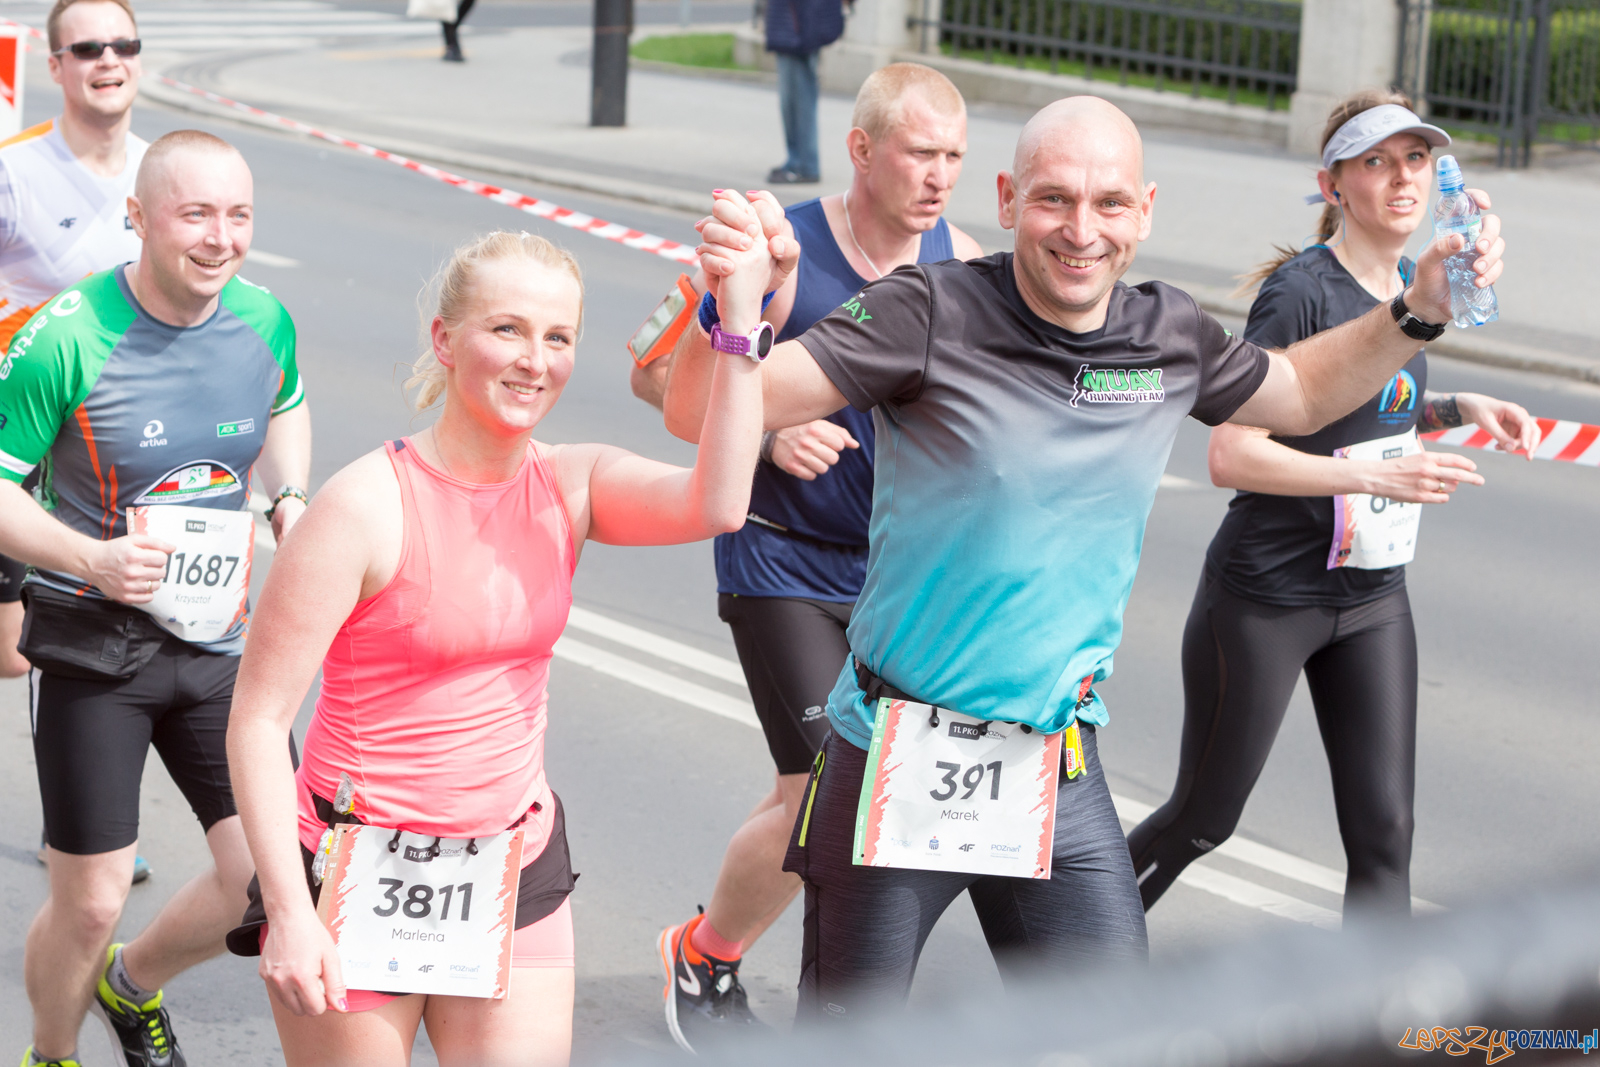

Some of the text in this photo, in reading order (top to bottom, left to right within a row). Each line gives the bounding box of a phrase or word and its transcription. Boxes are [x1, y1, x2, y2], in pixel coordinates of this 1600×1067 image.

[59, 217, 77, 228] 4F
[0, 315, 49, 381] artiva
[1082, 369, 1163, 392] MUAY
[1089, 392, 1164, 402] RUNNING TEAM
[237, 421, 253, 433] sport
[139, 436, 168, 448] artiva
[162, 552, 240, 587] 11687
[174, 593, 211, 604] Krzysztof
[929, 760, 1003, 802] 391
[940, 809, 980, 822] Marek
[958, 843, 975, 852] 4F
[372, 877, 474, 922] 3811
[391, 928, 445, 943] Marlena
[417, 964, 435, 973] 4F
